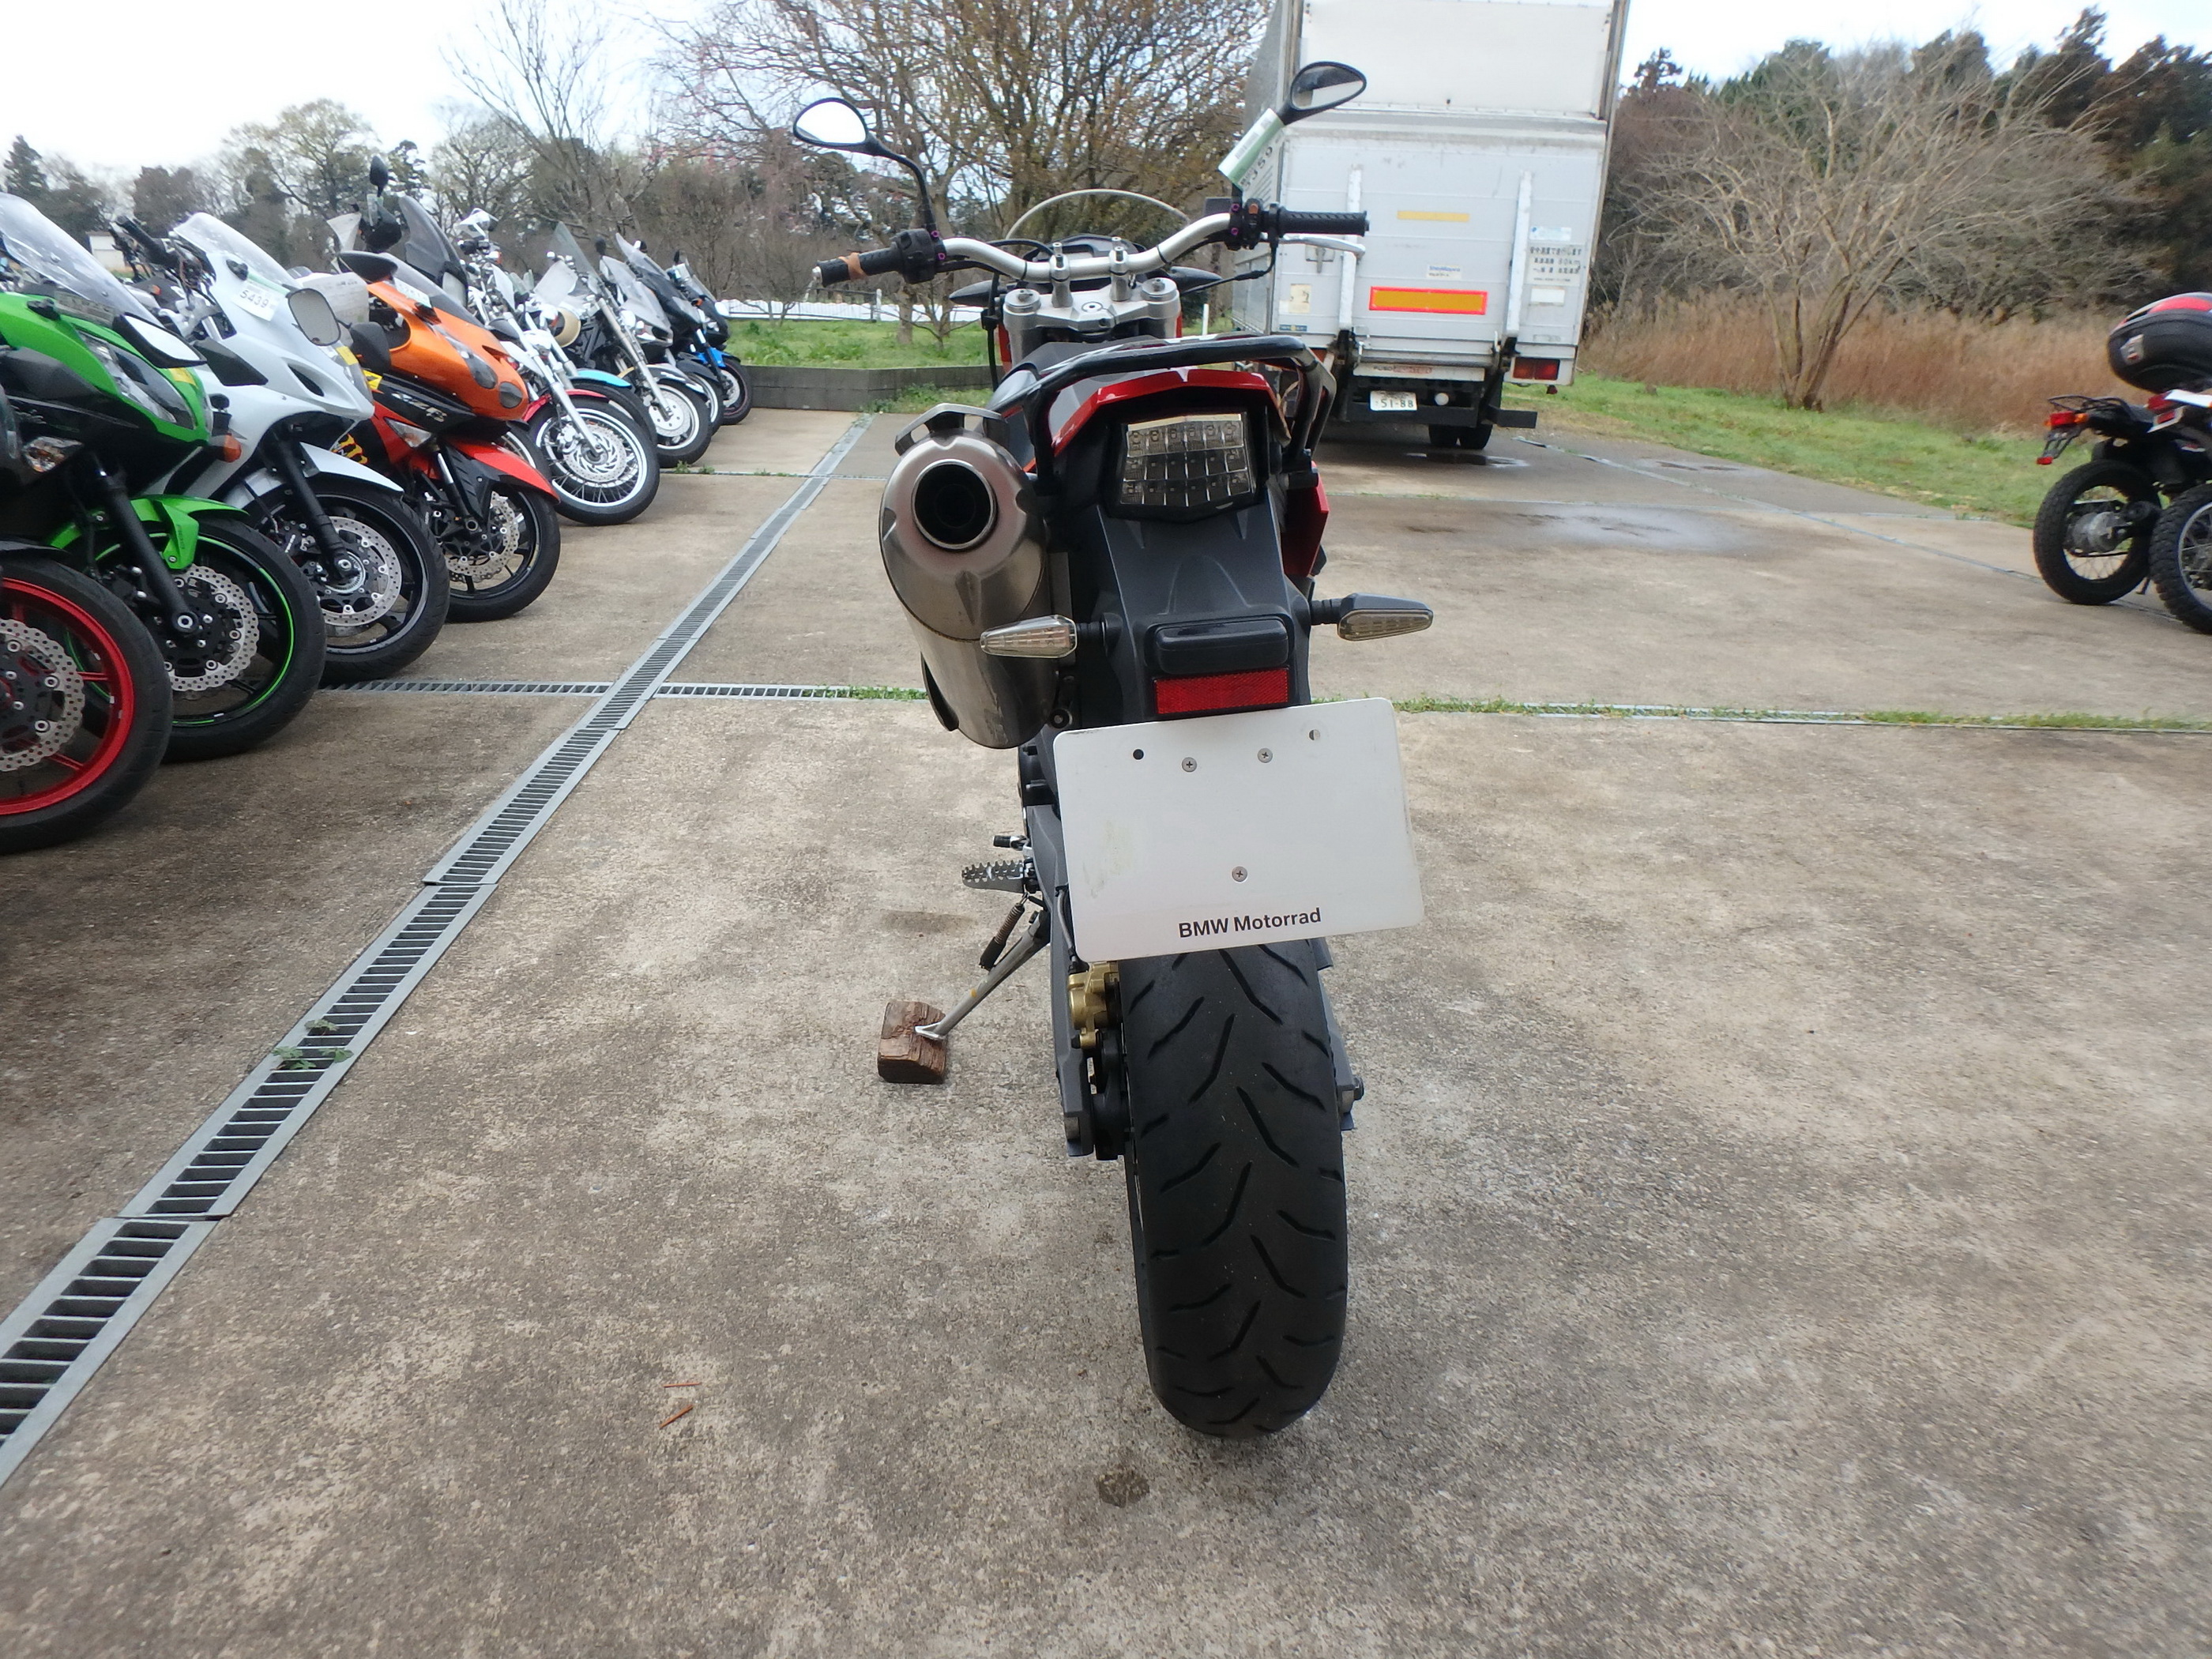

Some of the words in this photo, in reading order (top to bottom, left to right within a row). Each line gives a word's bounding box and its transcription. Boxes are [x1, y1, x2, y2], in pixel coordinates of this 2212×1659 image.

[239, 289, 269, 308] 5439
[1179, 914, 1228, 938] BMW
[1234, 907, 1322, 932] Motorrad
